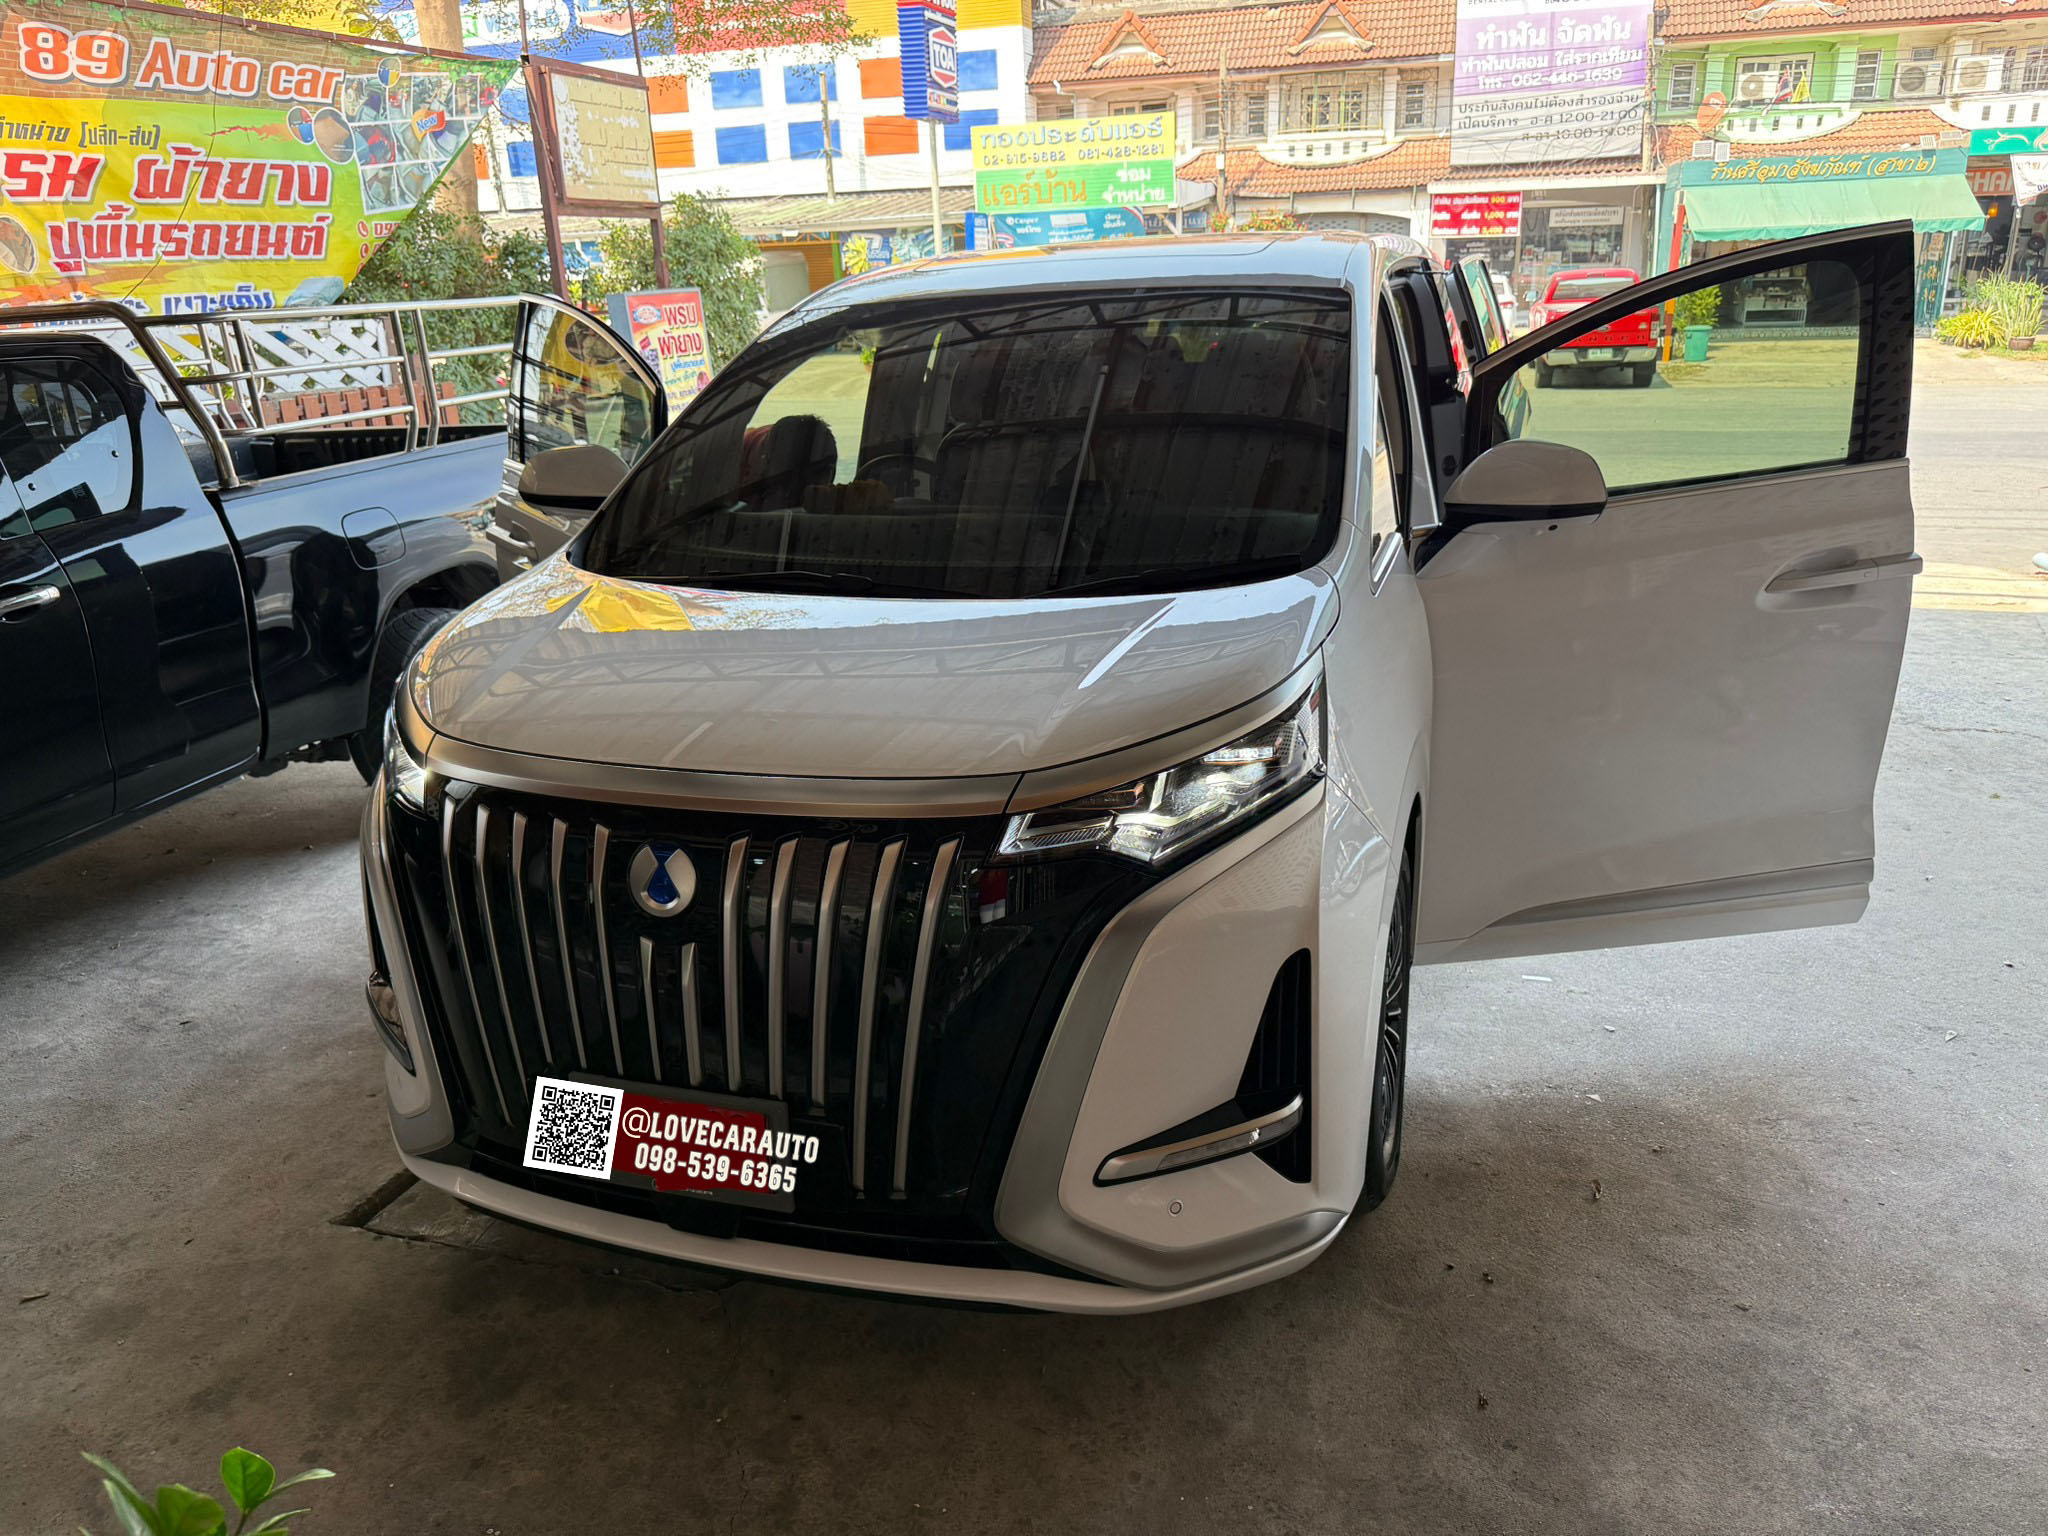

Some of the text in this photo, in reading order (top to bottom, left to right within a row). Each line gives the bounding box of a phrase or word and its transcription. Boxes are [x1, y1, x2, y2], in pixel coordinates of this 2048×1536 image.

[1476, 15, 1632, 49] ทำฟัน จัดฟัน
[20, 23, 345, 103] 89 Auto car
[933, 43, 956, 72] TOA
[416, 115, 439, 132] New
[981, 116, 1163, 150] ทองประดับแอร์
[133, 144, 331, 207] ผ้ายาง
[983, 168, 1088, 206] แอร์บ้าน
[47, 203, 331, 276] ปูพื้นรถยนต์
[662, 303, 699, 328] พรม
[657, 330, 704, 358] ผ้ายาง
